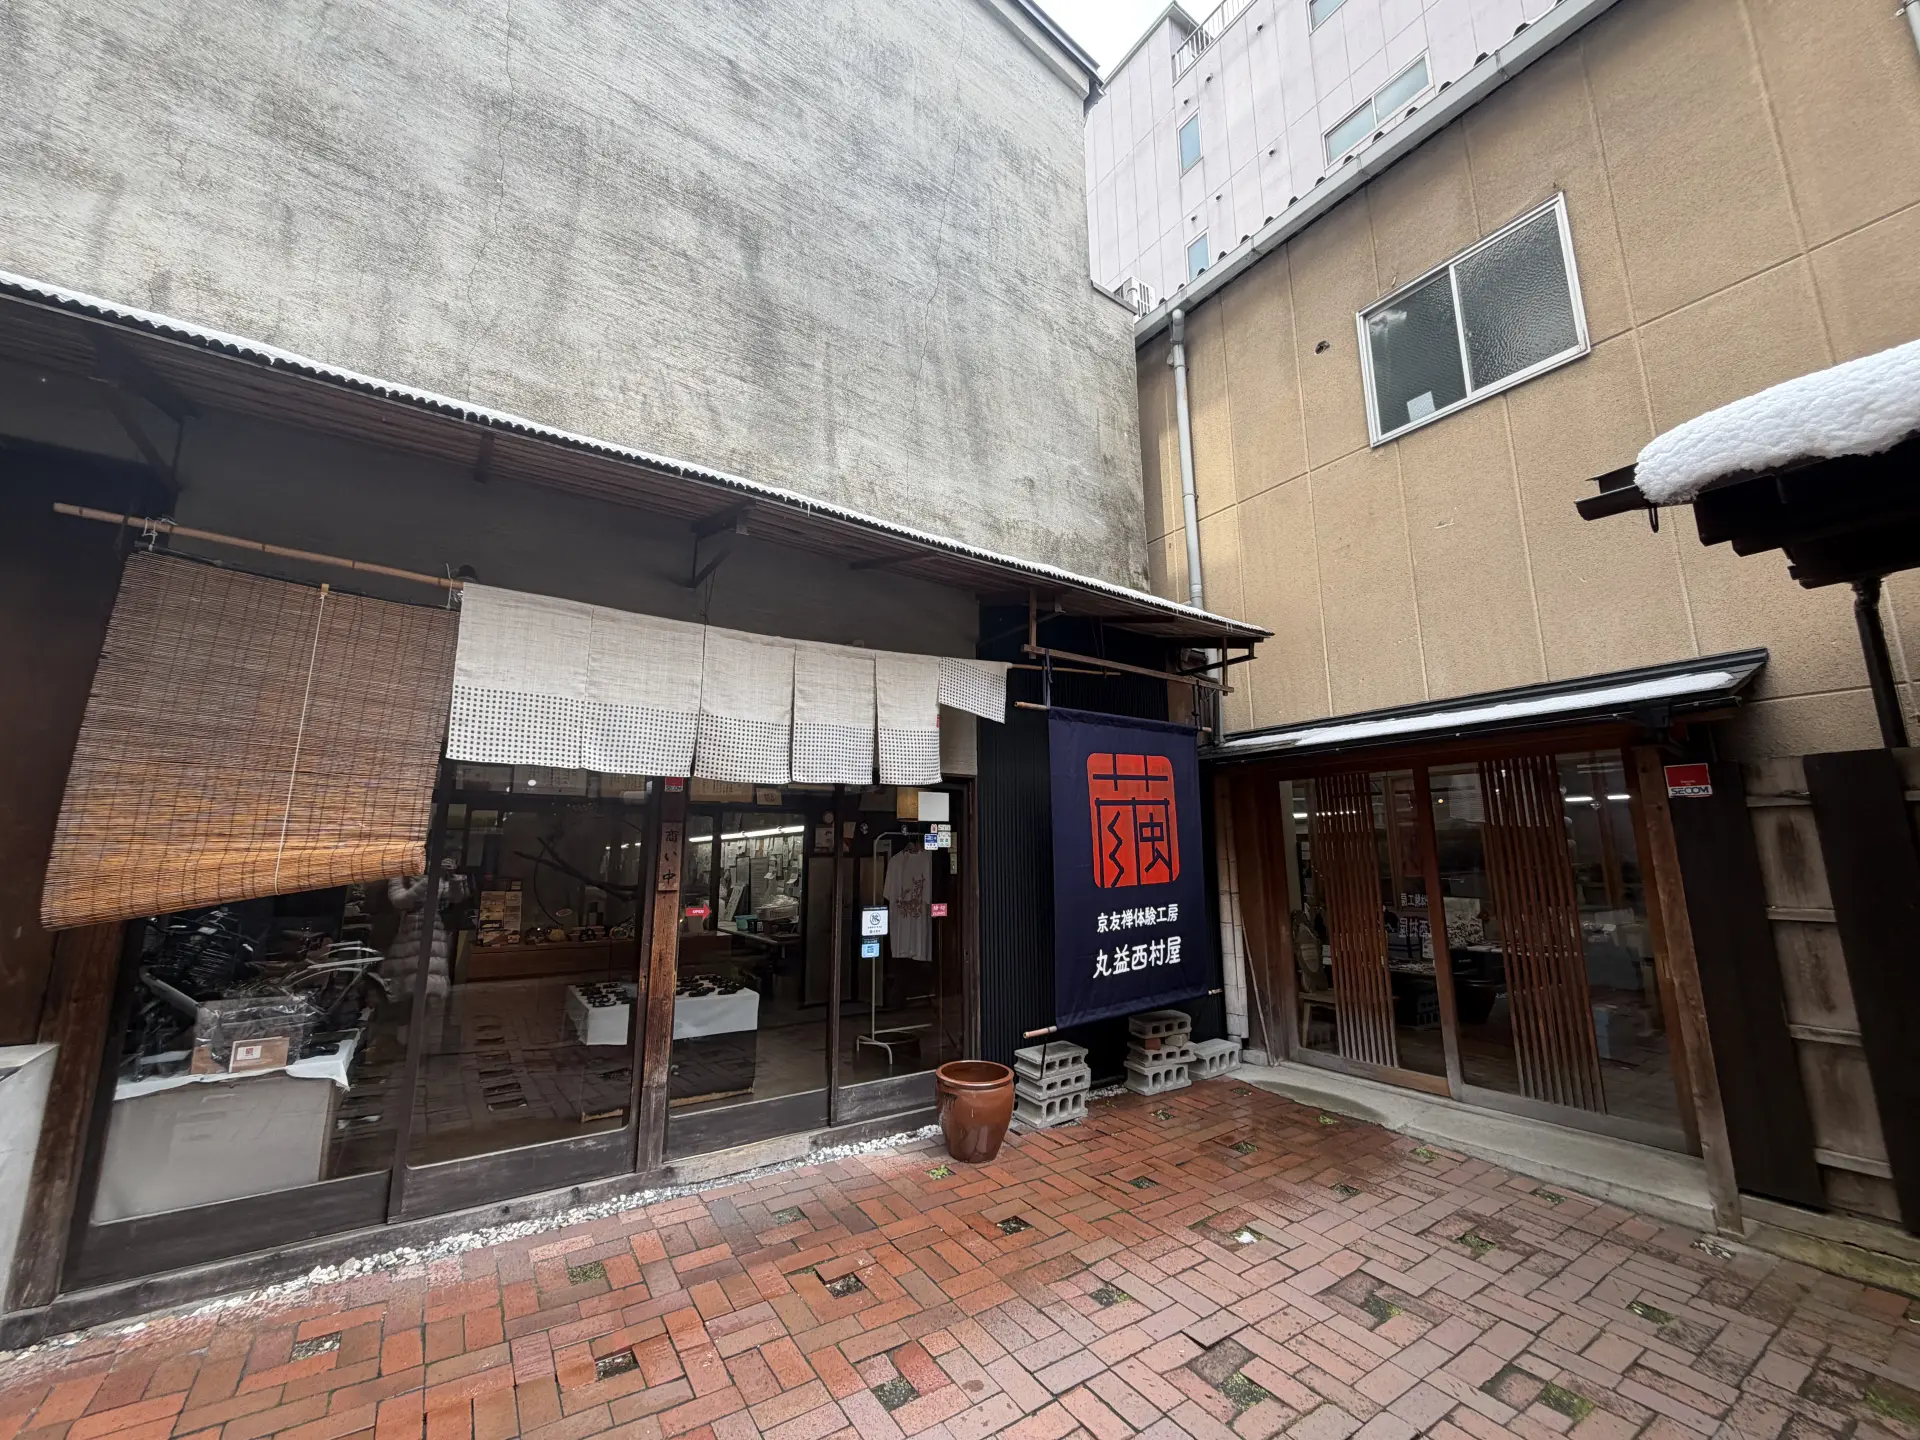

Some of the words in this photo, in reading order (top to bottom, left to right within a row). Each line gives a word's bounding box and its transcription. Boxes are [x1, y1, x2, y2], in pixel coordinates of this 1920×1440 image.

[1671, 786, 1709, 795] SECOM
[662, 829, 679, 885] 商い中
[1096, 903, 1179, 933] 京友禅体験工房
[1093, 936, 1181, 978] 丸益西村屋
